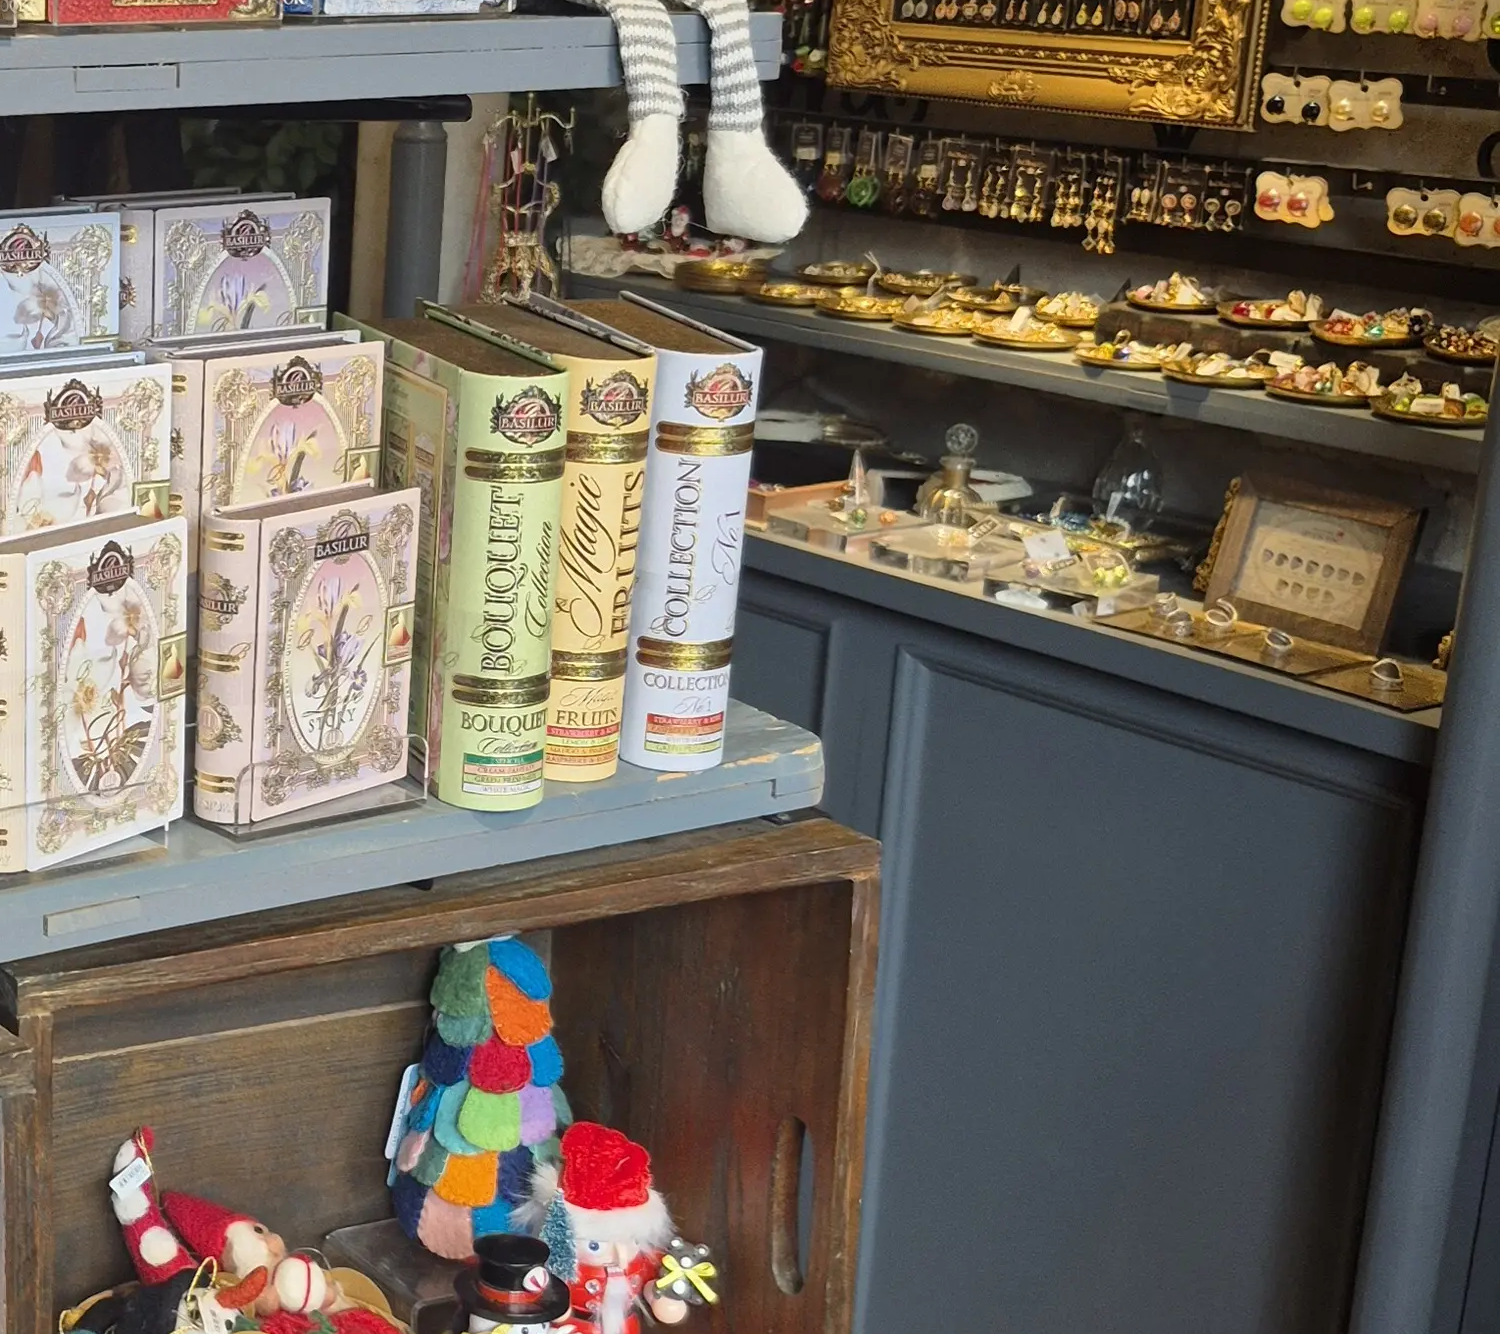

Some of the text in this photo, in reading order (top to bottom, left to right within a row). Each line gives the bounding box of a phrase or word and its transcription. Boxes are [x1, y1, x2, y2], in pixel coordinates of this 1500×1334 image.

[226, 234, 266, 246] BASILUR
[278, 382, 316, 395] BASILUR
[694, 391, 749, 406] BASILUR
[51, 405, 95, 419] BASILUR
[588, 399, 645, 413] BASILUR
[499, 414, 557, 432] BASILUR
[316, 534, 368, 558] BASILUR
[557, 473, 618, 630] Magic
[611, 468, 646, 639] FRUITS
[663, 457, 703, 638] COLLECTION
[93, 565, 129, 582] BASILUR
[480, 484, 527, 673] BOUQUET
[526, 521, 553, 641] Collection
[308, 707, 357, 734] STORY
[461, 708, 548, 736] BOUQUET
[556, 709, 617, 726] FRUITS
